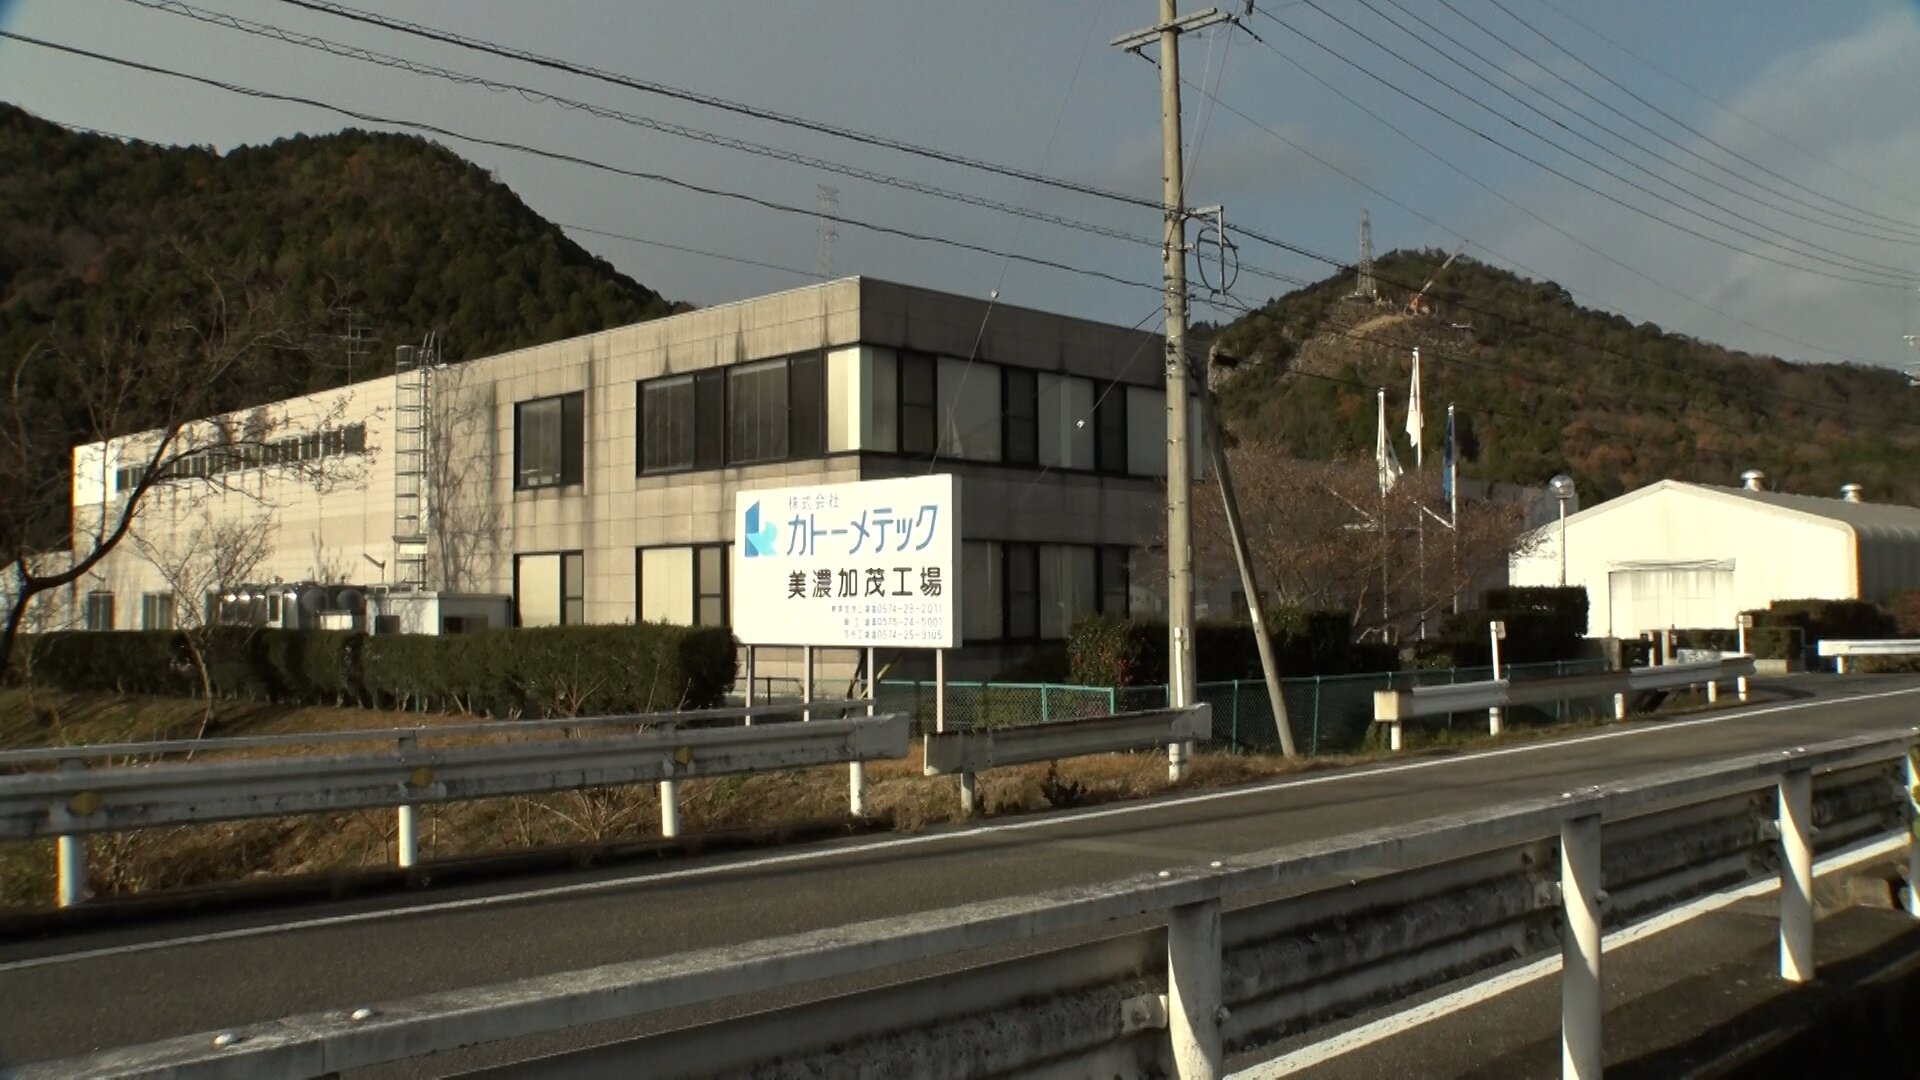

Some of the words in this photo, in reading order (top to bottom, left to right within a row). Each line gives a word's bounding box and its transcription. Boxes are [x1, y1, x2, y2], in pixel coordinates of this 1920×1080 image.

[789, 493, 840, 511] 株式会社
[786, 504, 938, 555] カトーメテック
[788, 566, 942, 599] 美濃加茂工場
